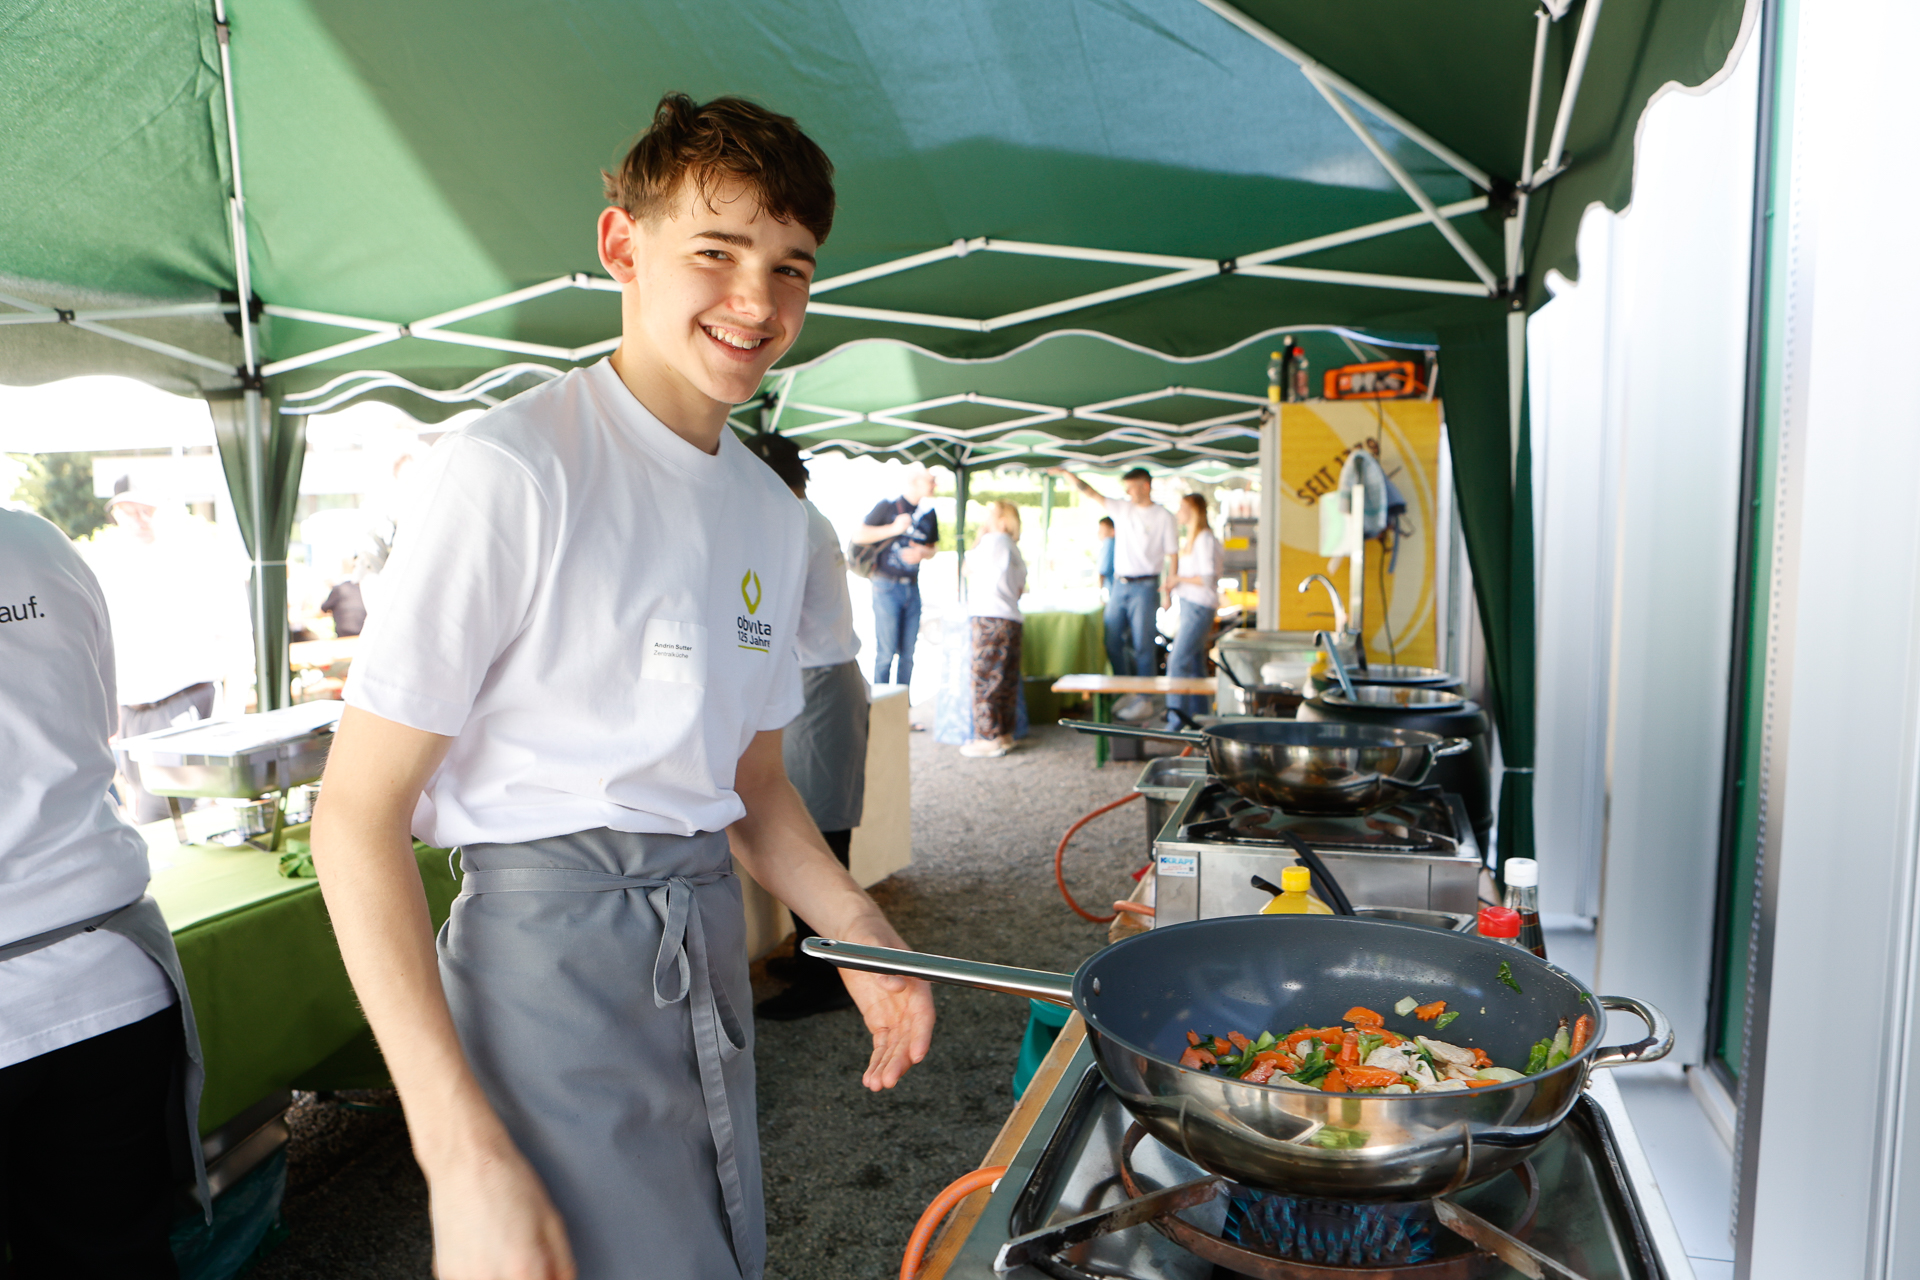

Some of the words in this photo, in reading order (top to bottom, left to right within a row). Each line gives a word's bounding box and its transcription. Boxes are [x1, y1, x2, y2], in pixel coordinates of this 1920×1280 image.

[1296, 465, 1336, 506] SEIT
[737, 615, 772, 636] obvita
[737, 630, 749, 643] 125
[654, 642, 675, 650] Andrin
[675, 643, 693, 651] Sutter
[653, 649, 689, 659] Zentralküche
